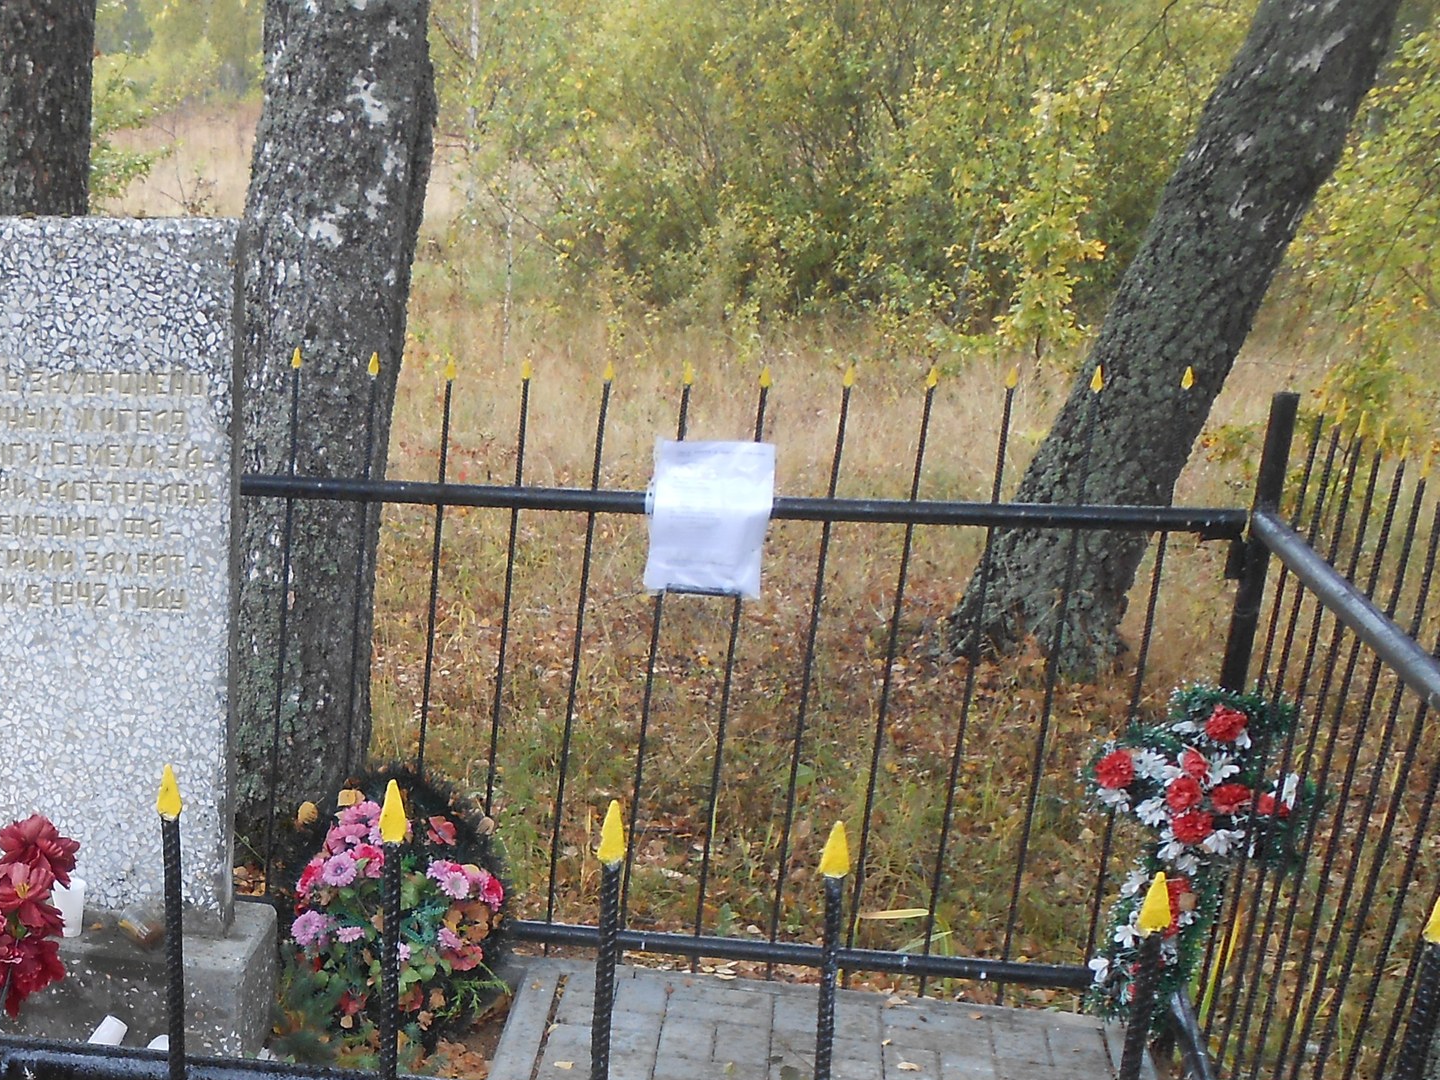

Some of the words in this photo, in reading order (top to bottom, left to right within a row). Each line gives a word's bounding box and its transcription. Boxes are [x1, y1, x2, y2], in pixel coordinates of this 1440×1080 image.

[30, 370, 205, 397] ЗАХОРОНЕНО
[76, 407, 185, 434] ЖИТЕЛЯ
[26, 584, 42, 608] В
[52, 581, 109, 609] 1942
[119, 586, 186, 613] ГОДУ
